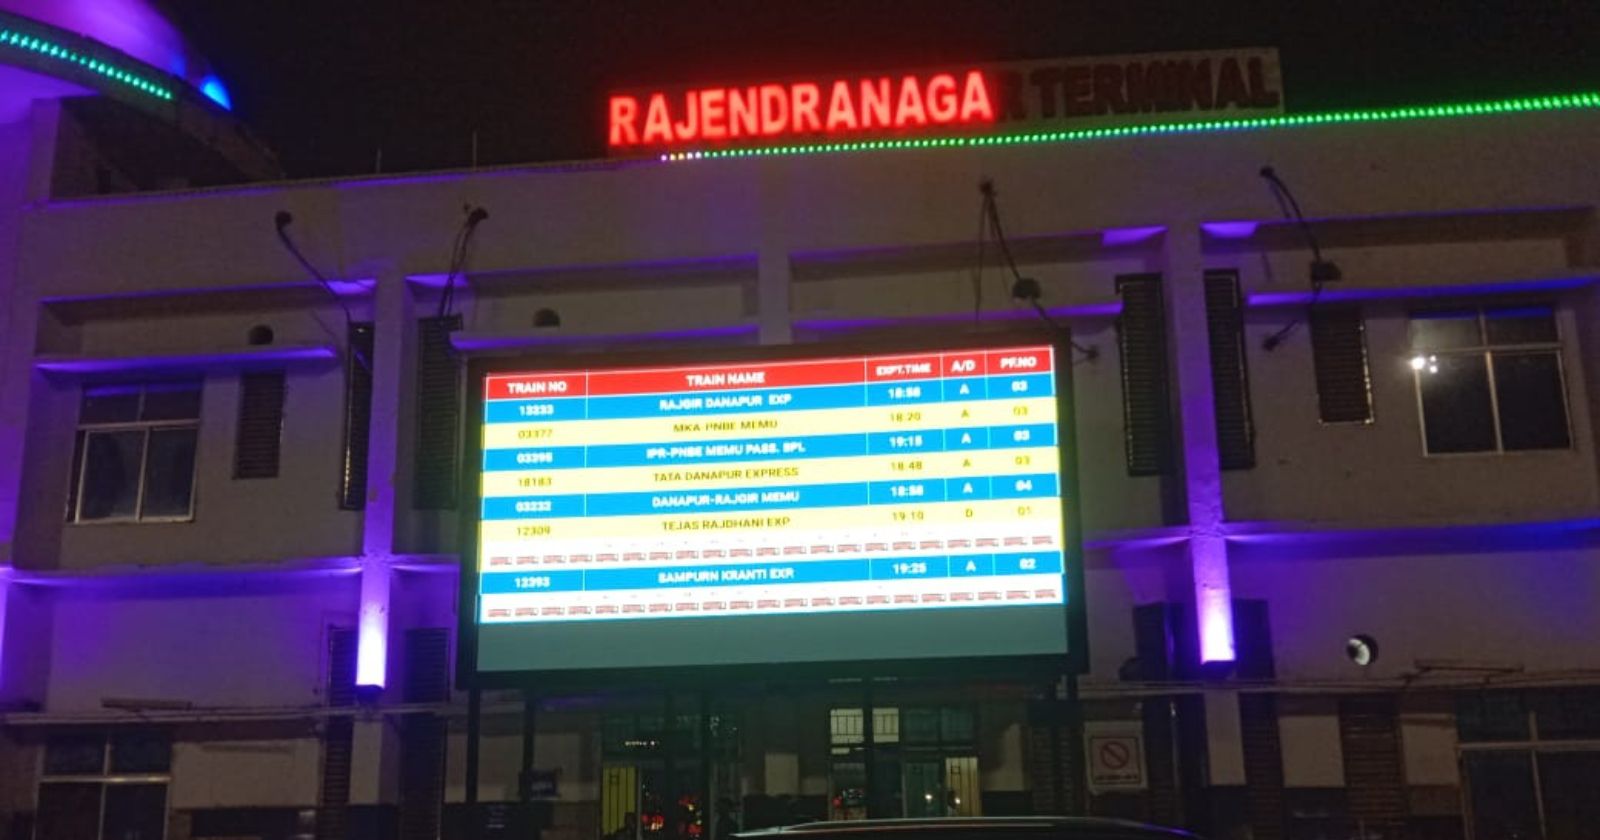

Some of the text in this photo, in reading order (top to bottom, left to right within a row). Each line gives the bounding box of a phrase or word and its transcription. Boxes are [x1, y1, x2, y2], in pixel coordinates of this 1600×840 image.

[1031, 57, 1279, 117] TERMINAL
[952, 360, 975, 371] A/D
[687, 372, 764, 386] TRAIN NAME
[508, 381, 566, 393] TRAIN NO
[960, 384, 969, 394] A
[660, 394, 791, 410] RAJGIR DANAPUR EXP
[960, 409, 971, 418] A
[1012, 406, 1028, 416] 03
[890, 412, 921, 422] 1820
[741, 420, 778, 429] MEMU
[517, 428, 553, 440] 03377
[962, 433, 971, 443] A
[706, 446, 743, 455] MEMU
[891, 460, 923, 471] 1848
[962, 458, 972, 468] A
[1015, 455, 1031, 466] 03
[652, 466, 800, 483] TATA DANAPUR EXPRESS
[964, 483, 972, 492] A
[892, 510, 925, 521] 1910
[965, 508, 973, 518] D
[1017, 506, 1032, 517] 01
[662, 517, 790, 530] TEJAS RAJDHANI EXP
[516, 525, 551, 537] 12309
[966, 561, 976, 571] A
[659, 571, 719, 583] SAMPURN
[721, 569, 767, 580] KRANTI
